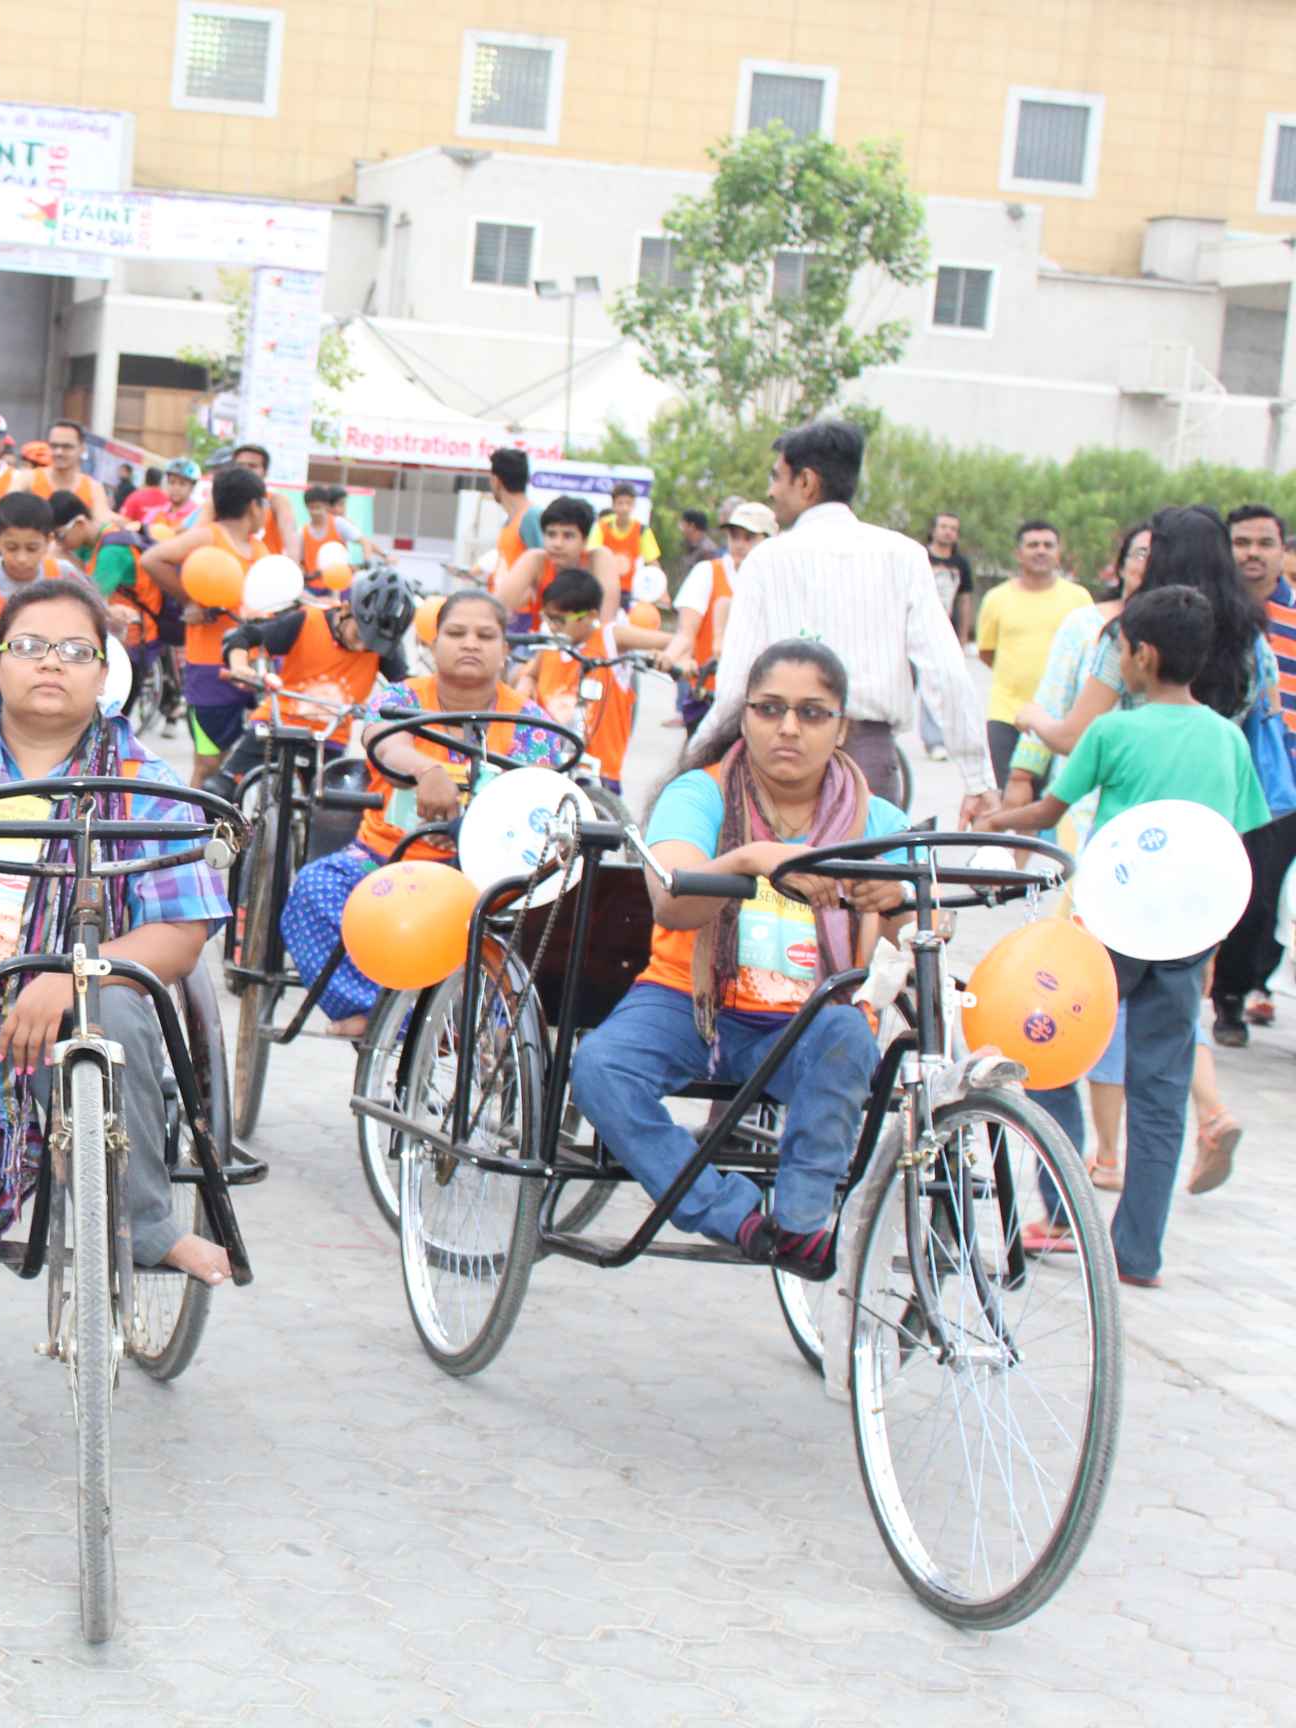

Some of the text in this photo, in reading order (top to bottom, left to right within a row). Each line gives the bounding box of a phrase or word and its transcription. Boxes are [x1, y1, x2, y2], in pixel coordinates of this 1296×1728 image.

[47, 144, 71, 194] 016
[62, 201, 138, 225] PAINT
[344, 425, 472, 456] Registration
